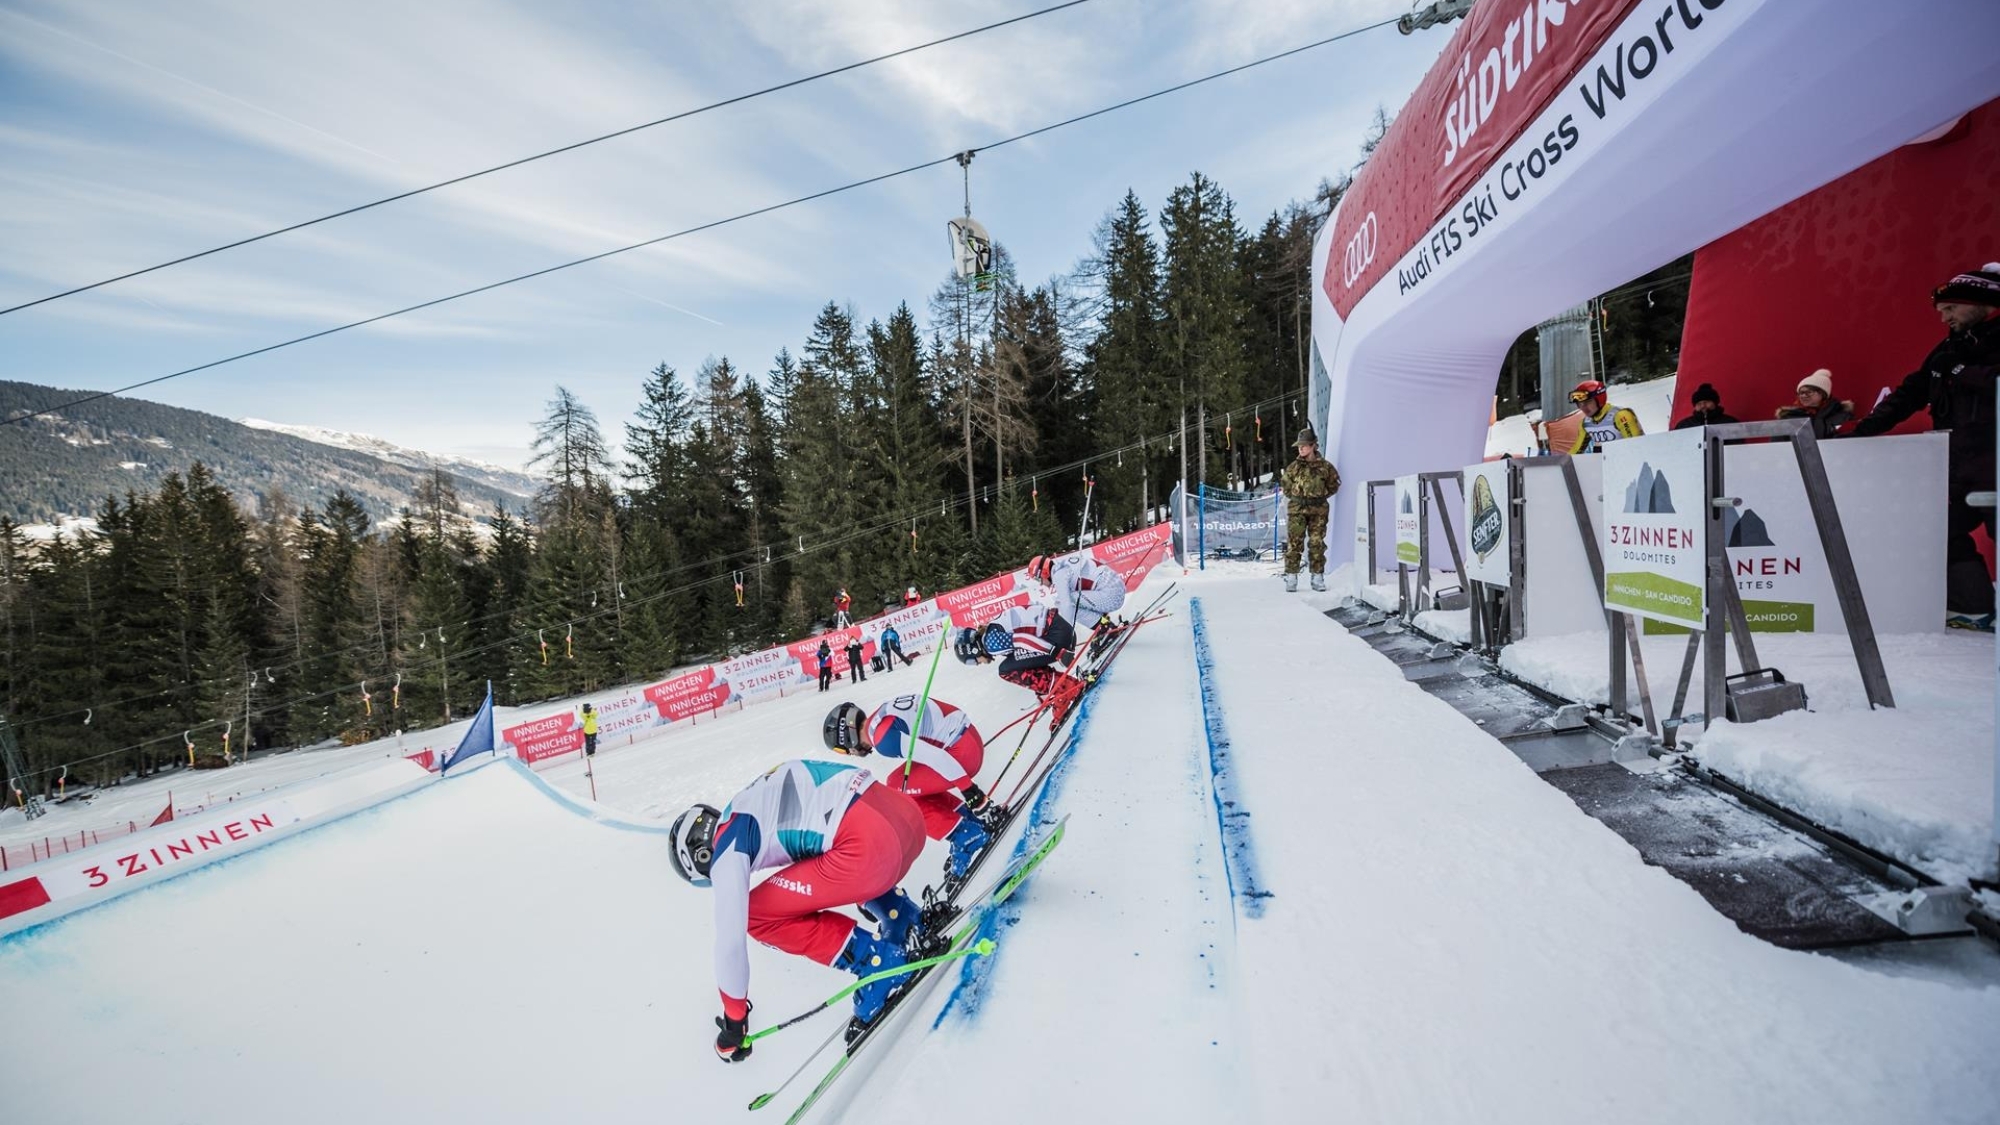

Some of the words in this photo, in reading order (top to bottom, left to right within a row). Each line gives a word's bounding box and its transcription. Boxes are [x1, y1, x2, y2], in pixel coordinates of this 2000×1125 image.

[1398, 247, 1432, 296] Audi
[1431, 218, 1462, 265] FIS
[1463, 183, 1499, 238] Ski
[1501, 114, 1579, 201] Cross
[1104, 530, 1158, 555] INNICHEN
[1623, 551, 1676, 565] DOLOMITES
[949, 582, 1001, 605] INNICHEN
[1659, 592, 1693, 606] CANDIDO
[1745, 613, 1798, 623] CANDIDO
[901, 622, 944, 643] INNEN
[734, 652, 780, 671] ZINNEN
[655, 675, 703, 698] INNICHEN
[746, 668, 795, 688] ZINNEN
[600, 696, 638, 714] INNEN
[670, 691, 718, 713] INNICHEN
[514, 718, 563, 738] INNICHEN
[604, 712, 652, 733] ZINNEN
[838, 716, 847, 746] GIRO
[527, 734, 577, 754] INNICHEN
[82, 865, 109, 888] 3
[116, 813, 275, 878] ZINNEN
